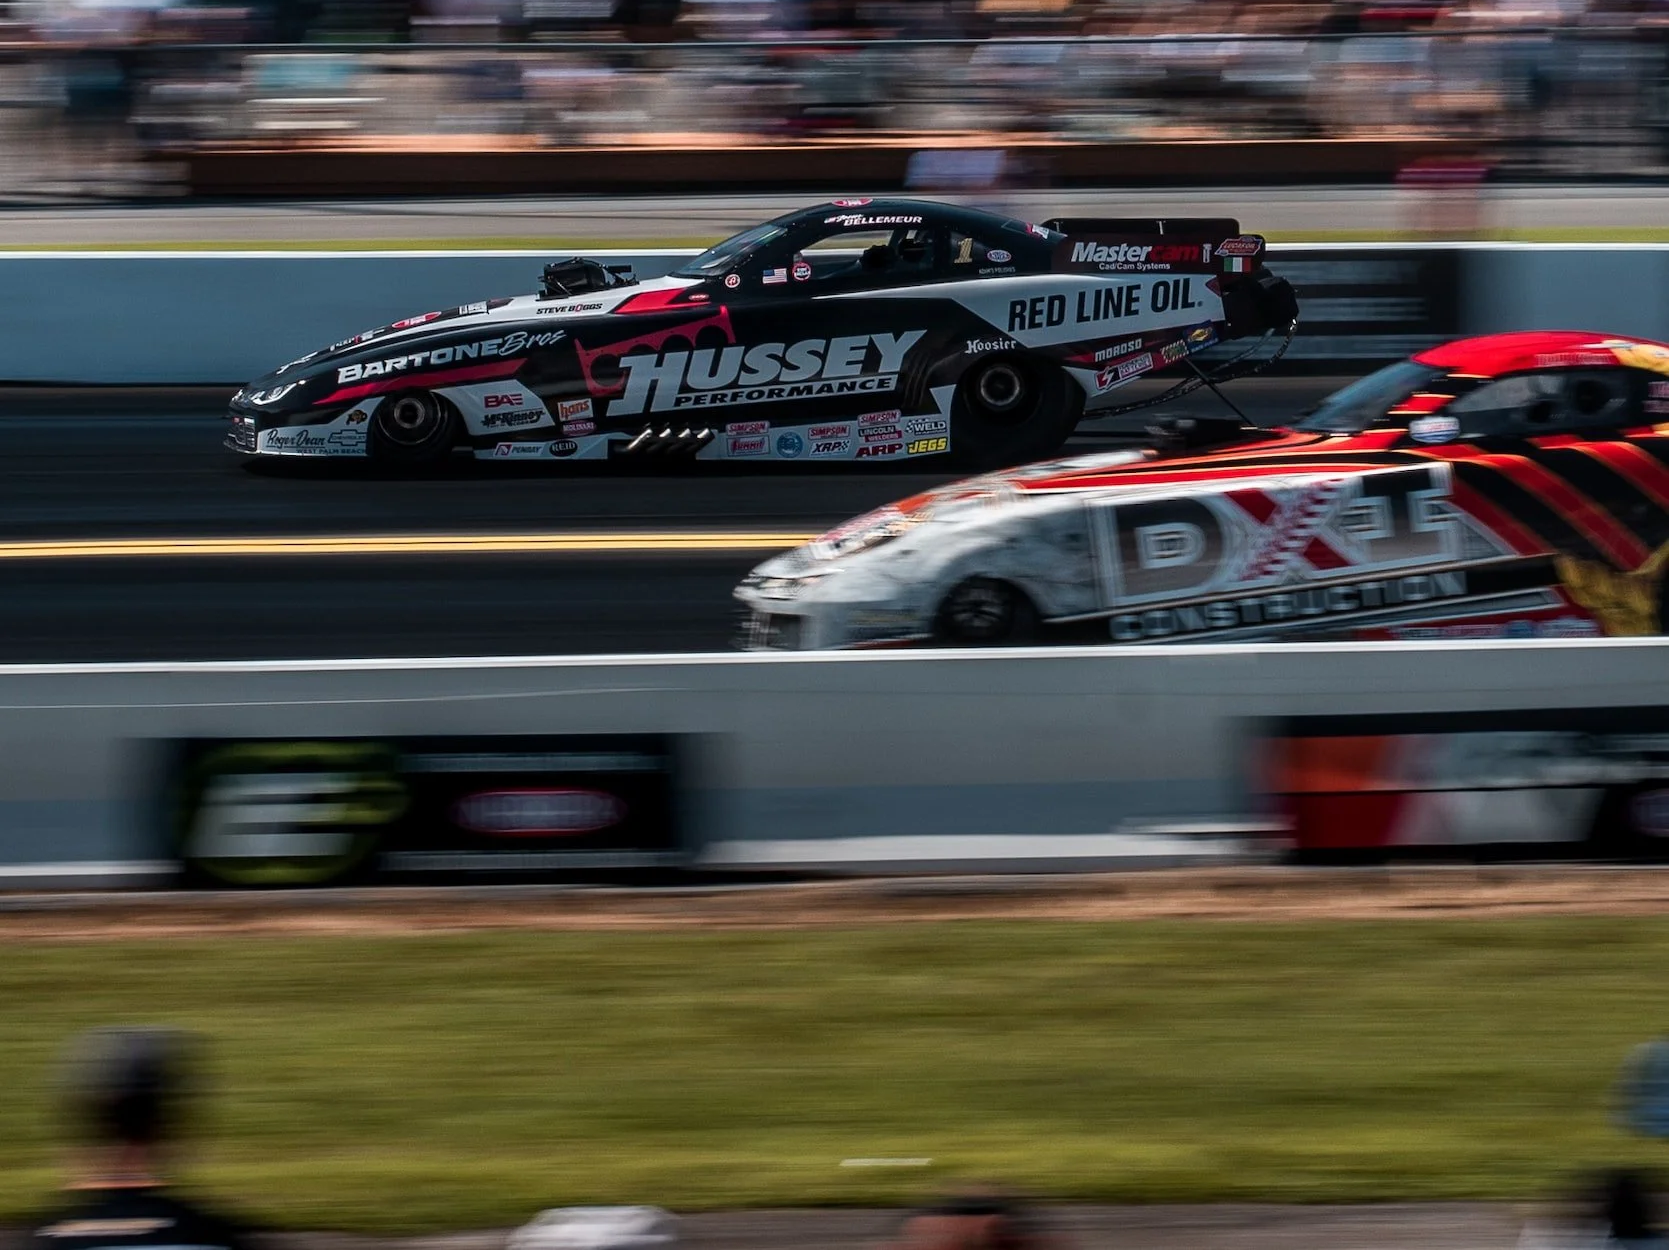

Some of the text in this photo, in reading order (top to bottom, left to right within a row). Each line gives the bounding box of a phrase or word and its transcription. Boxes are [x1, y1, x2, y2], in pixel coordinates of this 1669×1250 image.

[843, 216, 923, 226] BELLEMEUR
[953, 237, 973, 264] 1
[1098, 262, 1171, 272] Cad/Cam Systems
[536, 303, 603, 315] STEVE BOGGS
[1008, 278, 1196, 333] RED LINE OIL
[964, 338, 1017, 355] Hoosier
[336, 338, 505, 385] BARTONE
[498, 329, 568, 357] Bros
[605, 329, 929, 418] HUSSEY
[673, 377, 893, 408] PERFORMANCE
[484, 393, 523, 408] BAE
[860, 411, 898, 424] SIMPSON
[729, 422, 767, 433] SIMPSON
[810, 425, 848, 437] SIMPSON
[859, 426, 895, 437] LINCOLN
[914, 421, 946, 432] WELD
[266, 429, 325, 449] Roger Dean
[867, 432, 899, 442] WELDERS
[551, 440, 576, 452] REID
[855, 443, 903, 458] ARP
[908, 437, 947, 454] JEGS
[1109, 571, 1468, 641] CONSTRUCTION
